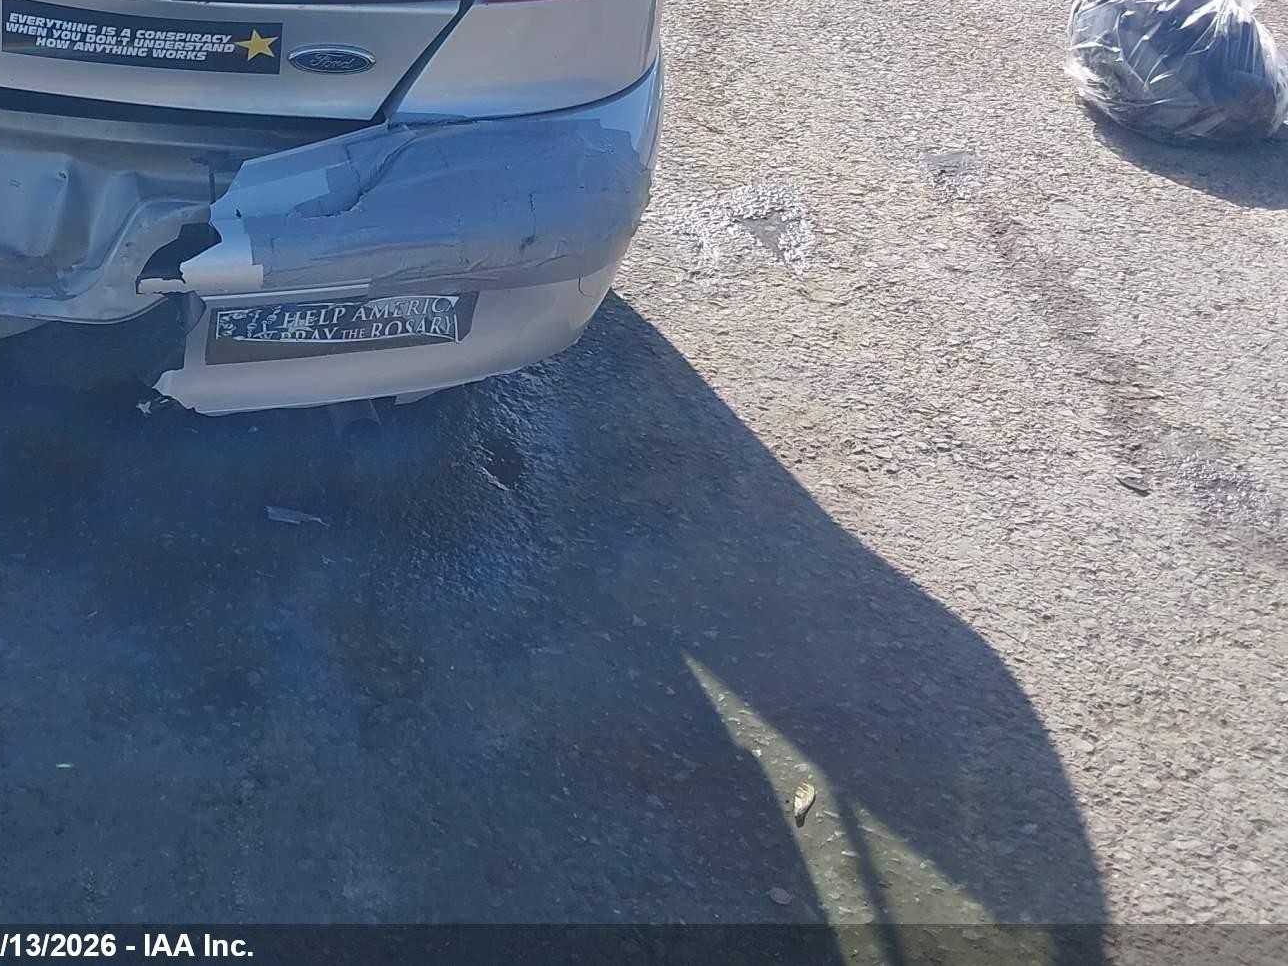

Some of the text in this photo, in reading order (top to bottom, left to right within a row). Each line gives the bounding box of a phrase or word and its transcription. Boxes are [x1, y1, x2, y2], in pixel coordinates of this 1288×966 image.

[6, 22, 235, 53] WHEN YOU DON'T UNDERSTAND
[9, 13, 232, 43] EVERYTHING IS A CONSPIRACY
[36, 37, 207, 61] HOW ANYTHING WORKS
[311, 52, 356, 69] Ford
[282, 307, 346, 329] HELP
[341, 328, 366, 340] THE
[370, 316, 457, 338] ROSARY
